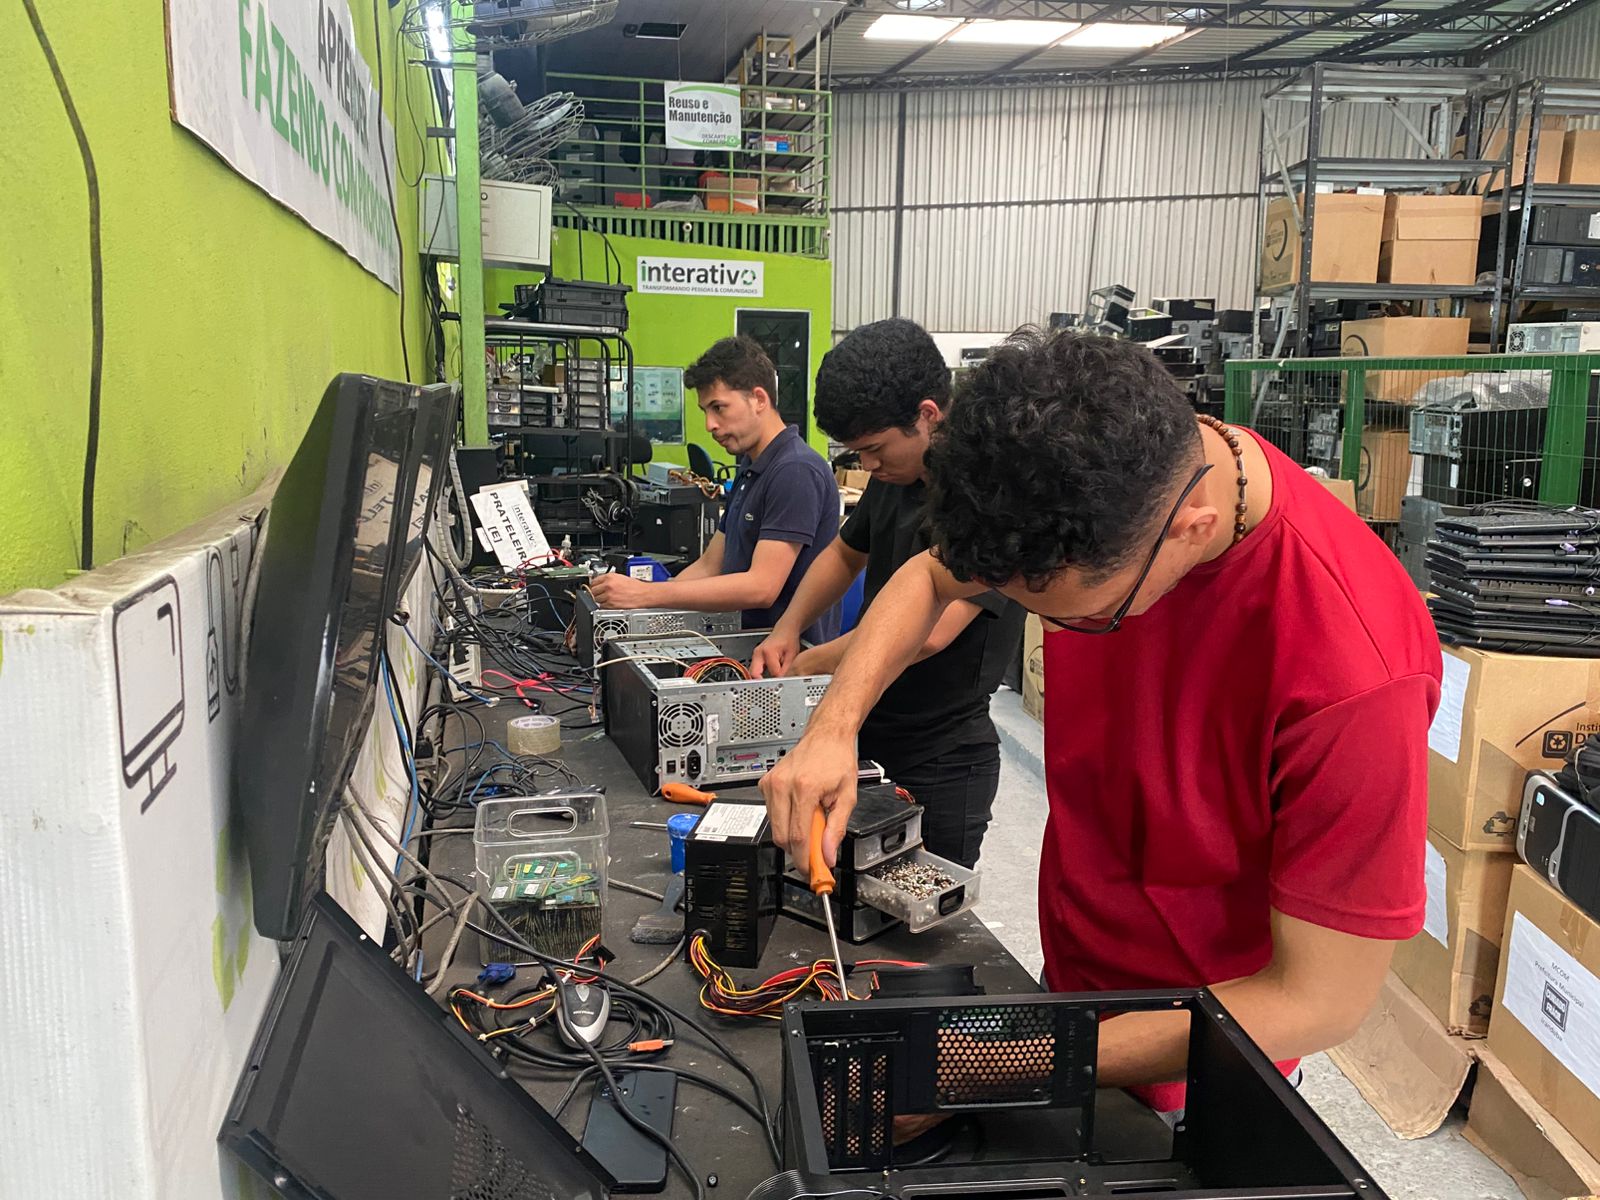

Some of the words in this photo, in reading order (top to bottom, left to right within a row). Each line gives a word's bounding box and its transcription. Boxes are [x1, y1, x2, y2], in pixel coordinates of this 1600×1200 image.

[318, 0, 369, 152] APRENDER
[238, 0, 330, 186] FAZENDO
[668, 96, 700, 109] Reuso
[702, 99, 709, 110] e
[668, 110, 732, 126] Manutenção
[641, 260, 757, 286] interativo
[642, 284, 690, 292] TRANSFORMANDO
[487, 525, 503, 543] [E]
[1576, 722, 1600, 732] Insti
[1551, 962, 1570, 982] MCOM
[1534, 960, 1559, 986] Prefeitura
[1558, 982, 1585, 1009] Municipal
